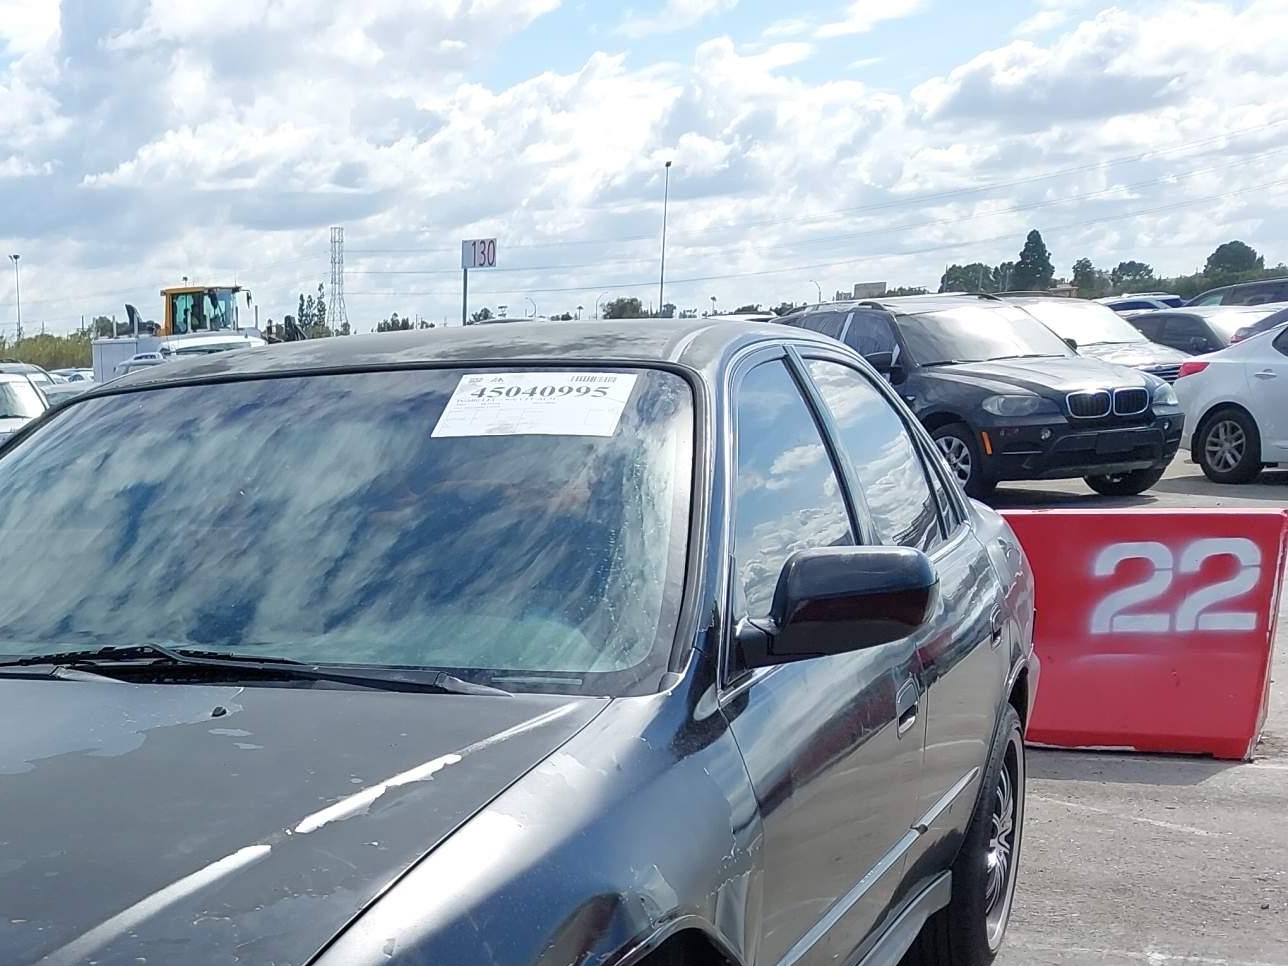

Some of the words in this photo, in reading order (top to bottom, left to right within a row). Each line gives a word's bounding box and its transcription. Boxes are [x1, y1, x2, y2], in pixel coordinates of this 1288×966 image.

[472, 240, 496, 267] 130
[470, 385, 609, 398] 45040995
[1090, 537, 1262, 634] 22
